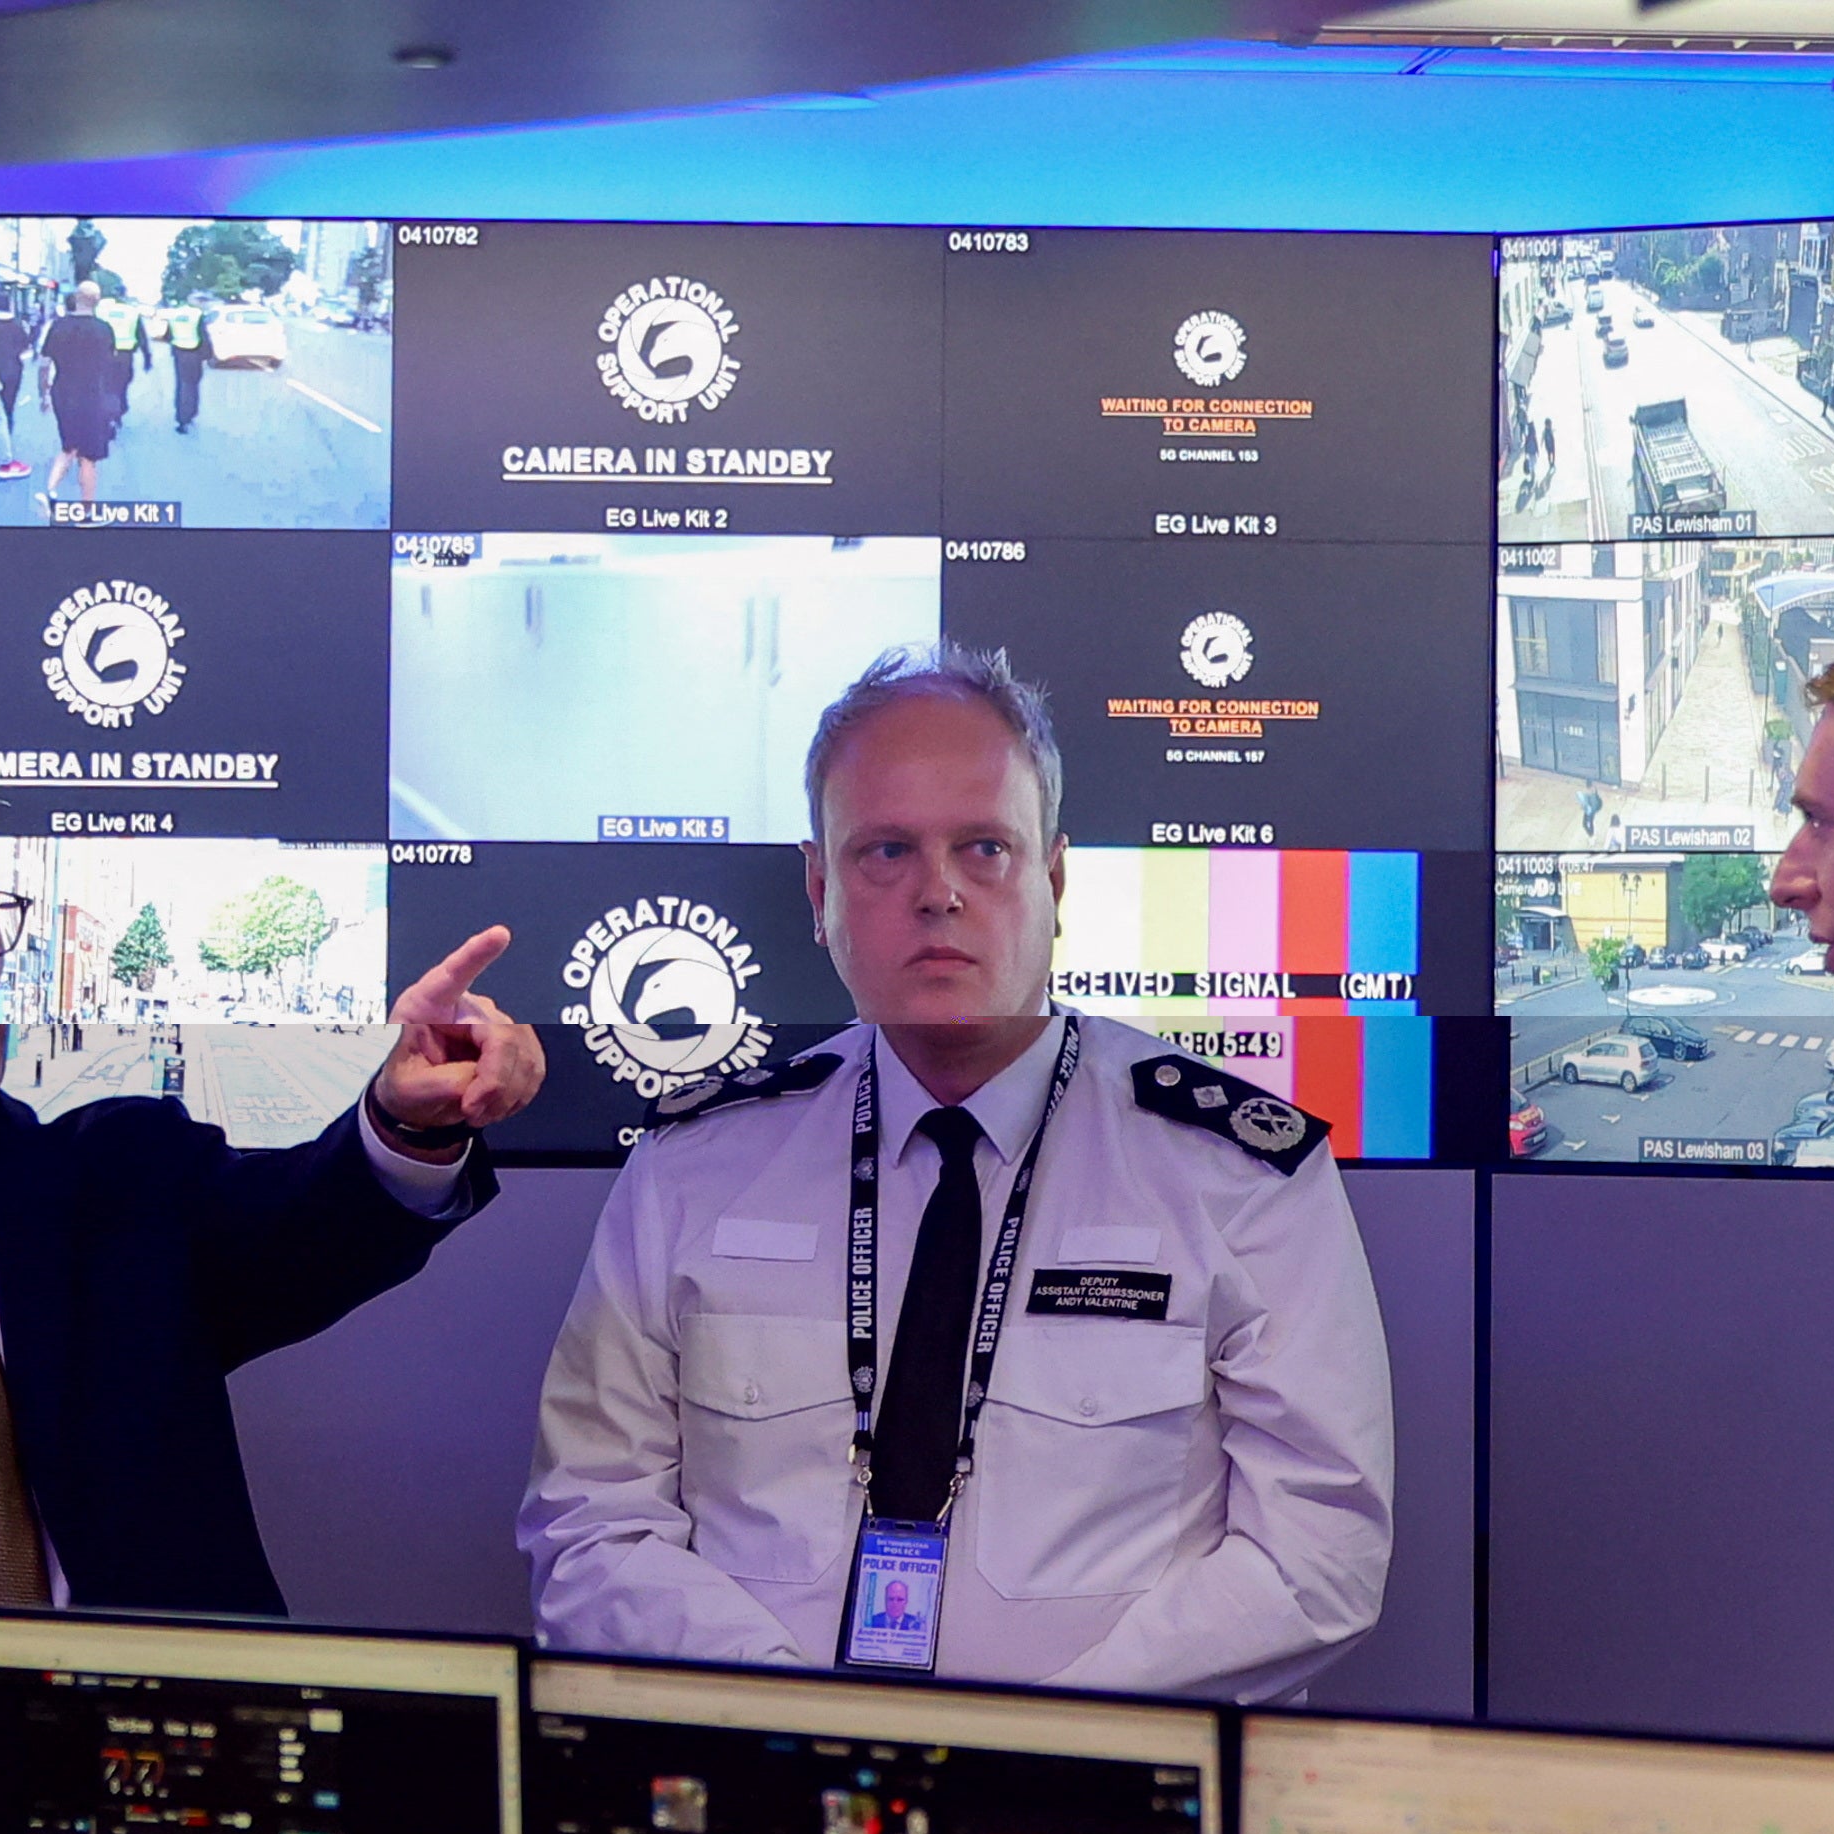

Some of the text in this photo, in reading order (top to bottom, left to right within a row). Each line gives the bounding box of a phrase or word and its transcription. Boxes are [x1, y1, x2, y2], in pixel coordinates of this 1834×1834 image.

[398, 226, 478, 246] 0410782
[948, 233, 1029, 253] 0410783
[1502, 239, 1557, 257] 0411001
[597, 275, 741, 344] OPERATIONAL
[597, 351, 741, 423] SUPPORT UNIT
[1101, 397, 1312, 417] WAITING FOR CONNECTION
[1162, 416, 1256, 434] TO CAMERA
[502, 444, 833, 477] CAMERA IN STANDBY
[1179, 449, 1235, 463] CHANNEL
[54, 501, 176, 523] EG Live Kit 1
[606, 507, 727, 528] EG Live Kit 2
[1156, 514, 1277, 535] EG Live Kit 3
[1633, 511, 1752, 535] PAS Lewisham 01
[394, 535, 475, 556] 0410785
[946, 541, 1026, 562] 0410786
[1501, 549, 1556, 566] 0411002
[42, 579, 187, 650] OPERATIONAL
[41, 656, 188, 729] SUPPORT UNIT
[1107, 698, 1319, 717] WAITING FOR CONNECTION
[1170, 717, 1262, 735] TO CAMERA
[1166, 748, 1265, 763] 5G CHANNEL 157
[90, 752, 123, 779] IN
[132, 752, 279, 781] STANDBY
[51, 811, 174, 833] EG Live Kit 4
[603, 818, 725, 838] EG Live Kit 5
[1151, 823, 1274, 845] EG Live Kit 6
[1631, 826, 1751, 846] PAS Lewisham 02
[391, 844, 472, 865] 0410778
[1498, 857, 1553, 874] 0411003
[562, 895, 762, 991] OPERATIONAL
[1194, 972, 1412, 1000] SIGNAL (GMT)
[1644, 1139, 1764, 1160] PAS Lewisham 03
[852, 1206, 874, 1340] POLICE OFFICER
[1080, 1277, 1119, 1287] DEPUTY
[975, 1216, 1020, 1355] POLICE OFFICER
[1035, 1287, 1165, 1302] ASSISTANT COMMISSIONER
[1055, 1297, 1139, 1310] ANDY VALENTINE
[883, 1547, 921, 1556] POLICE
[863, 1558, 938, 1574] POLICE OFFICER
